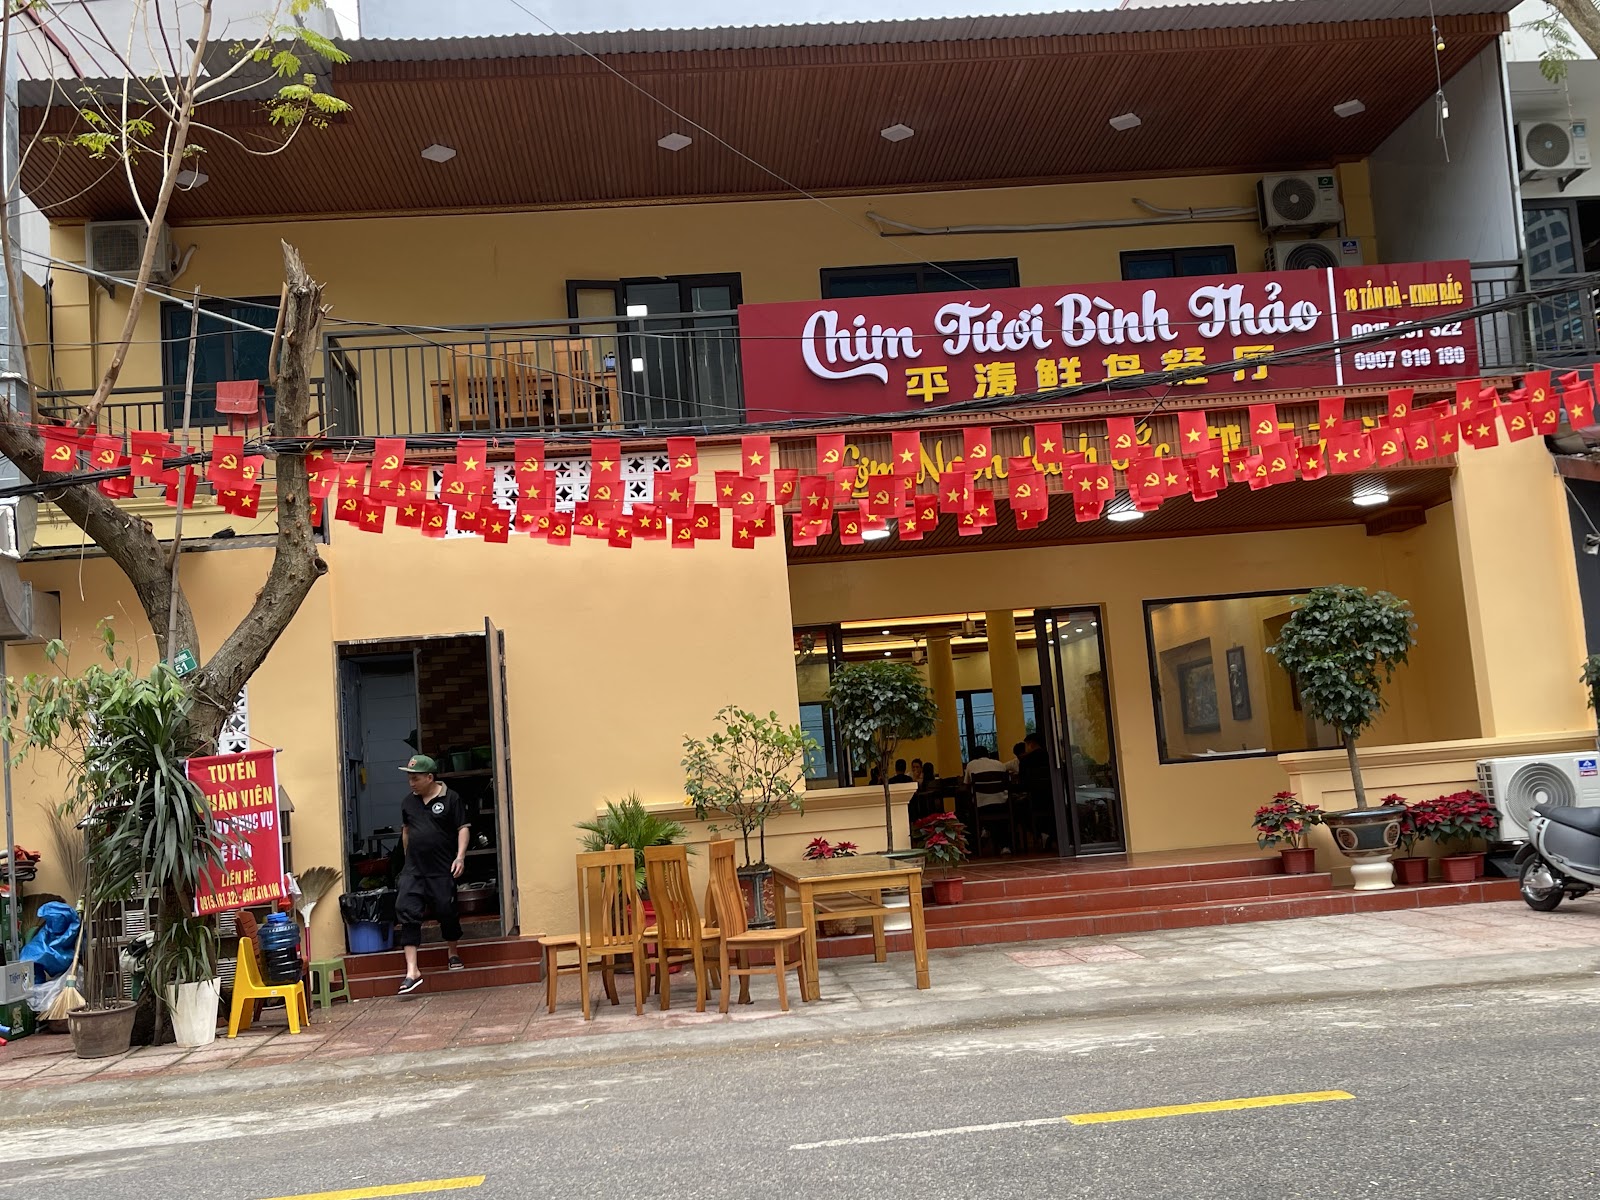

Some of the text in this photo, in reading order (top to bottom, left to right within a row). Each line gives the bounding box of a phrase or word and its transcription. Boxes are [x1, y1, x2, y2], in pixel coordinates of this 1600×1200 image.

[1343, 288, 1358, 311] 18
[1359, 280, 1383, 310] TẢN
[1409, 283, 1438, 307] KINH
[1439, 273, 1463, 305] BẮC
[802, 282, 1322, 384] Chim Tươi Bình Thảo
[1354, 346, 1466, 371] 0907 810 180
[175, 661, 189, 674] 51
[207, 755, 257, 784] TUYỂN
[240, 784, 273, 808] VIÊN
[260, 810, 274, 830] VỤ
[221, 866, 257, 887] LIÊN HỆ:
